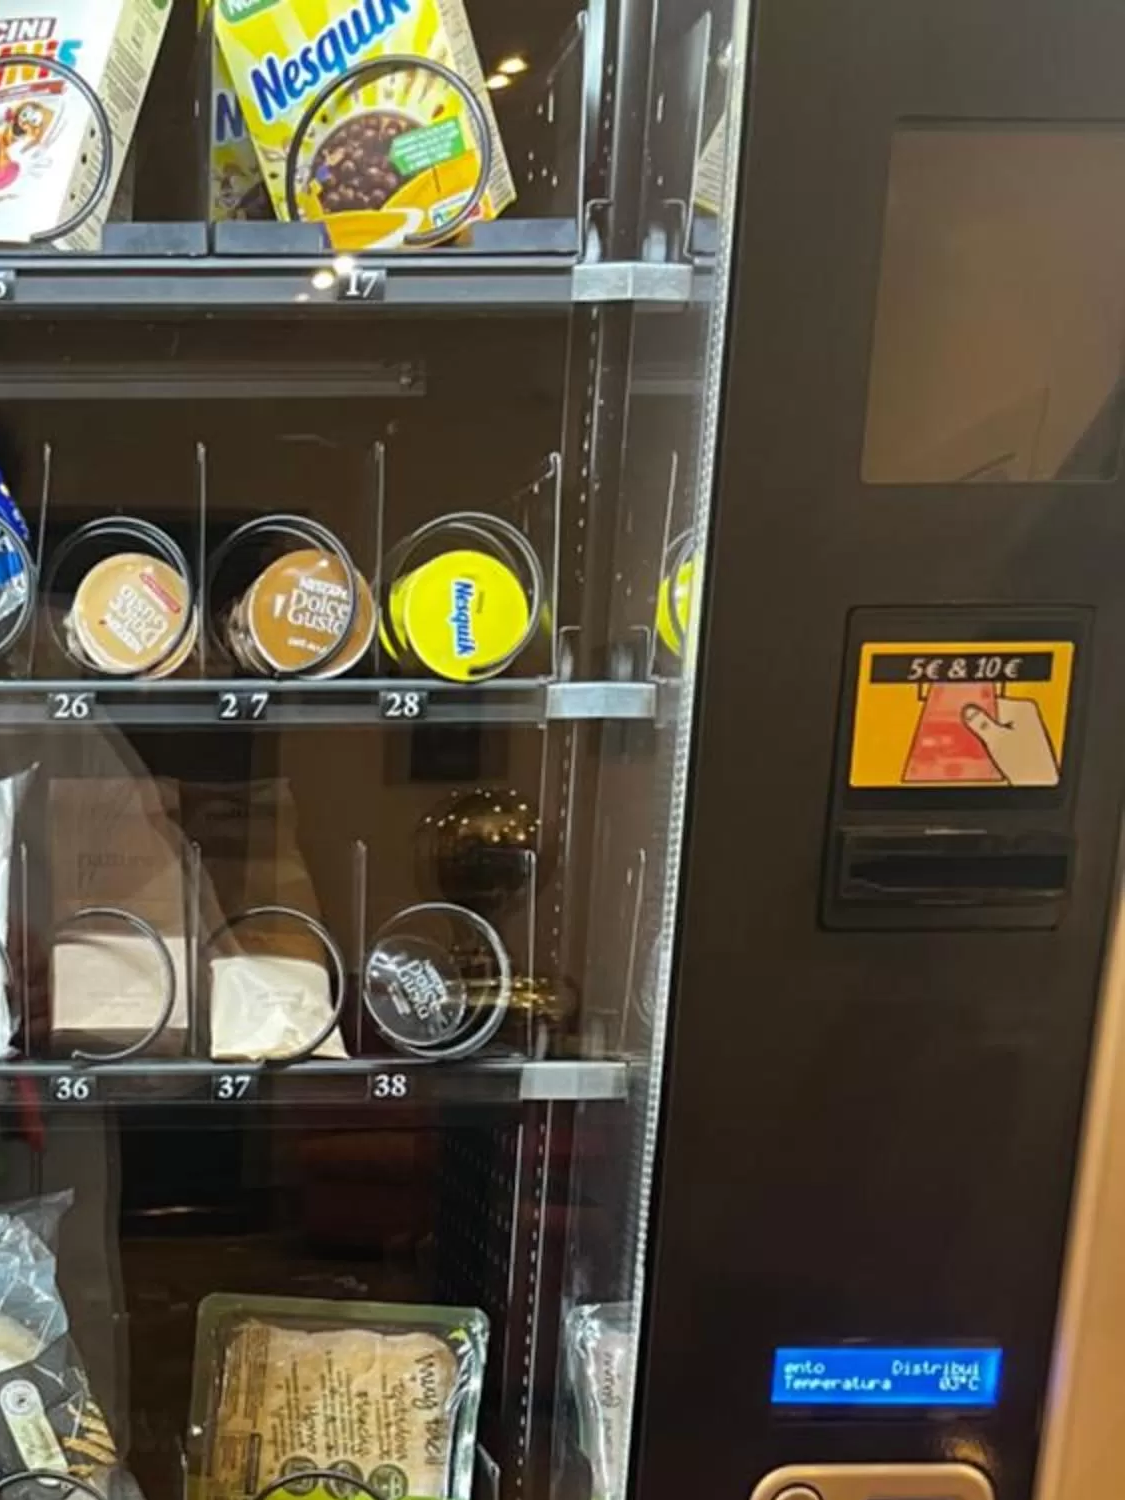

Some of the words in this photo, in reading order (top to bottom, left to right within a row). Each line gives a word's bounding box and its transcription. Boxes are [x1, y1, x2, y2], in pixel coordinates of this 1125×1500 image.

[344, 270, 380, 298] 17
[290, 588, 350, 620] Dolce
[450, 580, 476, 657] Nesquik
[947, 657, 967, 679] &
[53, 692, 89, 719] 26
[220, 692, 270, 719] 27
[384, 691, 420, 717] 28
[55, 1076, 90, 1101] 36
[217, 1075, 253, 1099] 37
[374, 1074, 409, 1098] 38
[783, 1360, 826, 1375] ento
[890, 1360, 981, 1377] Distribui
[783, 1375, 892, 1392] Temperatura
